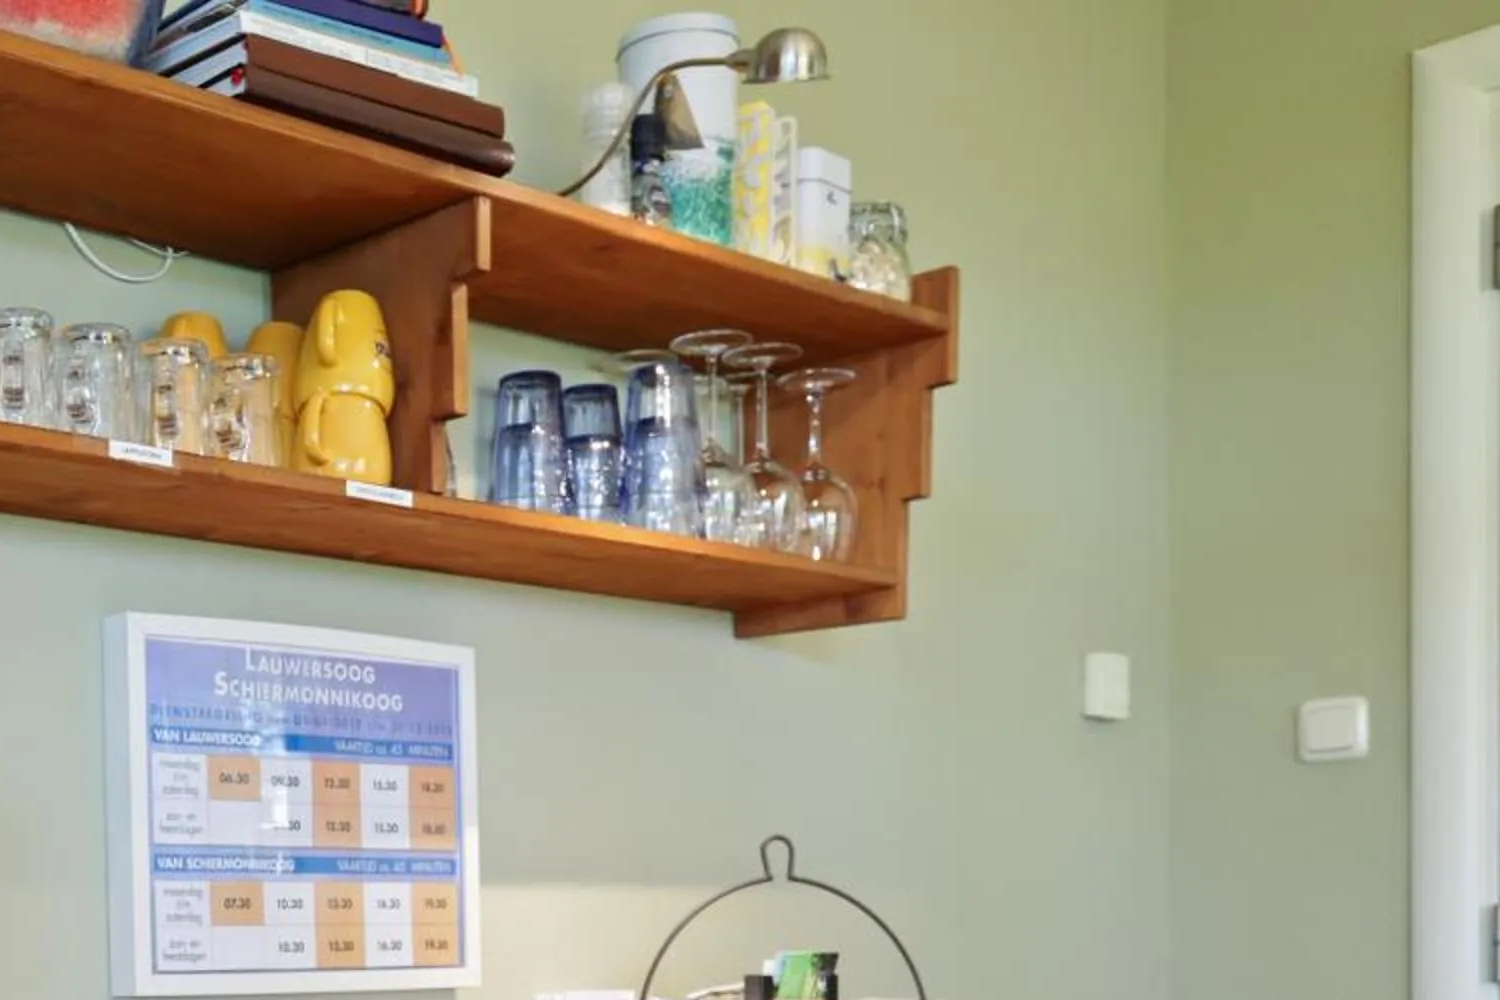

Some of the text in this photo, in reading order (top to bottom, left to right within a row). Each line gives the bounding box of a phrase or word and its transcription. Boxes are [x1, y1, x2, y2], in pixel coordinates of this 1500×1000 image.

[245, 646, 376, 685] LAUWERSOOG
[214, 671, 404, 712] SCHIERMONNIKOOG
[153, 728, 181, 743] VAN
[157, 857, 184, 870] VAN
